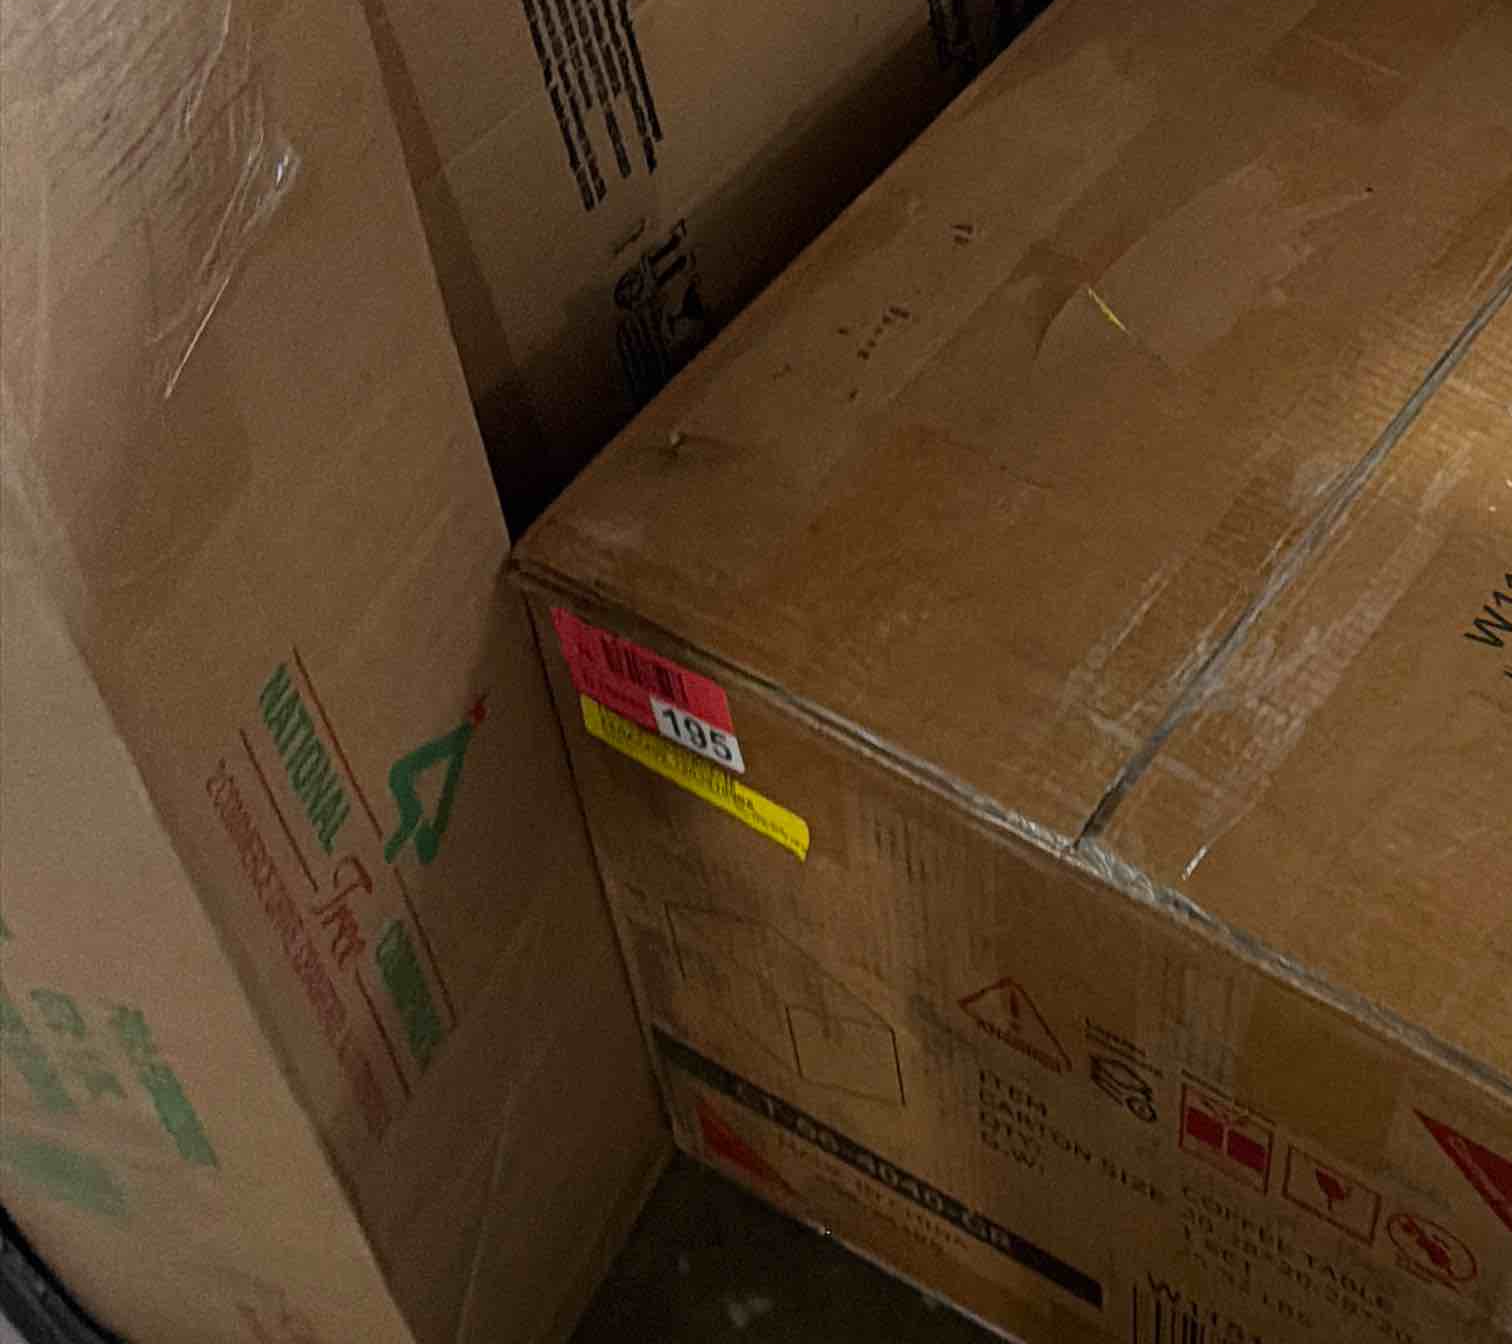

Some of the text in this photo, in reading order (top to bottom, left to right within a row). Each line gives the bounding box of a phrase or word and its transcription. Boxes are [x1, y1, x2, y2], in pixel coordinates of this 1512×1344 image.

[258, 662, 351, 856] NATIONAL
[660, 707, 734, 763] 195
[978, 1067, 1048, 1117] ITEM
[977, 1087, 1162, 1204] CARTON SIZE
